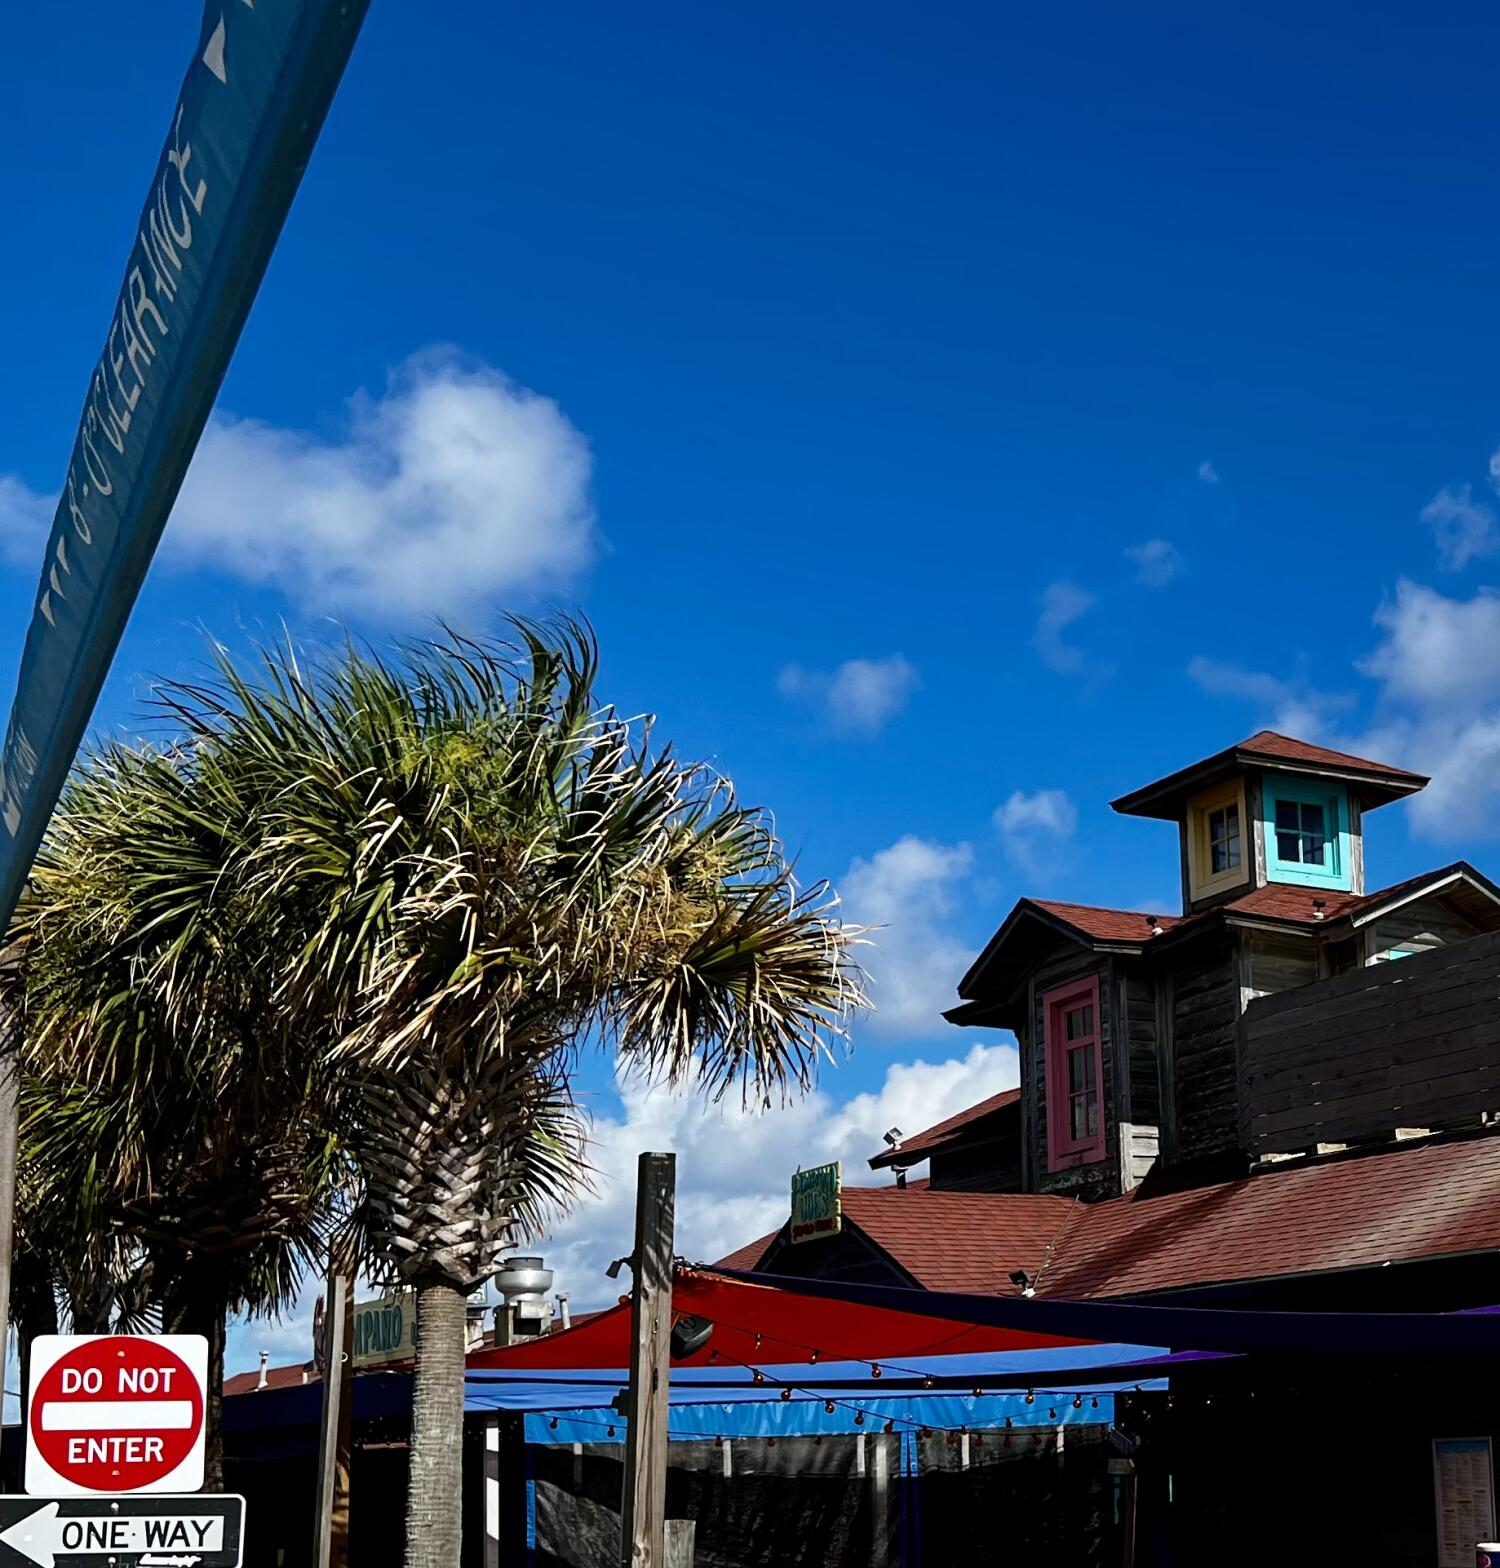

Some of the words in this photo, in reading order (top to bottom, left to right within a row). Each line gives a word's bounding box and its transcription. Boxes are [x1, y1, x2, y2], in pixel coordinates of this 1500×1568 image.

[93, 103, 208, 455] CLEARANCE
[62, 1368, 104, 1394] DO
[118, 1367, 177, 1393] NOT
[67, 1438, 165, 1464] ENTER
[62, 1521, 130, 1549] ONE
[144, 1520, 214, 1548] WAY
